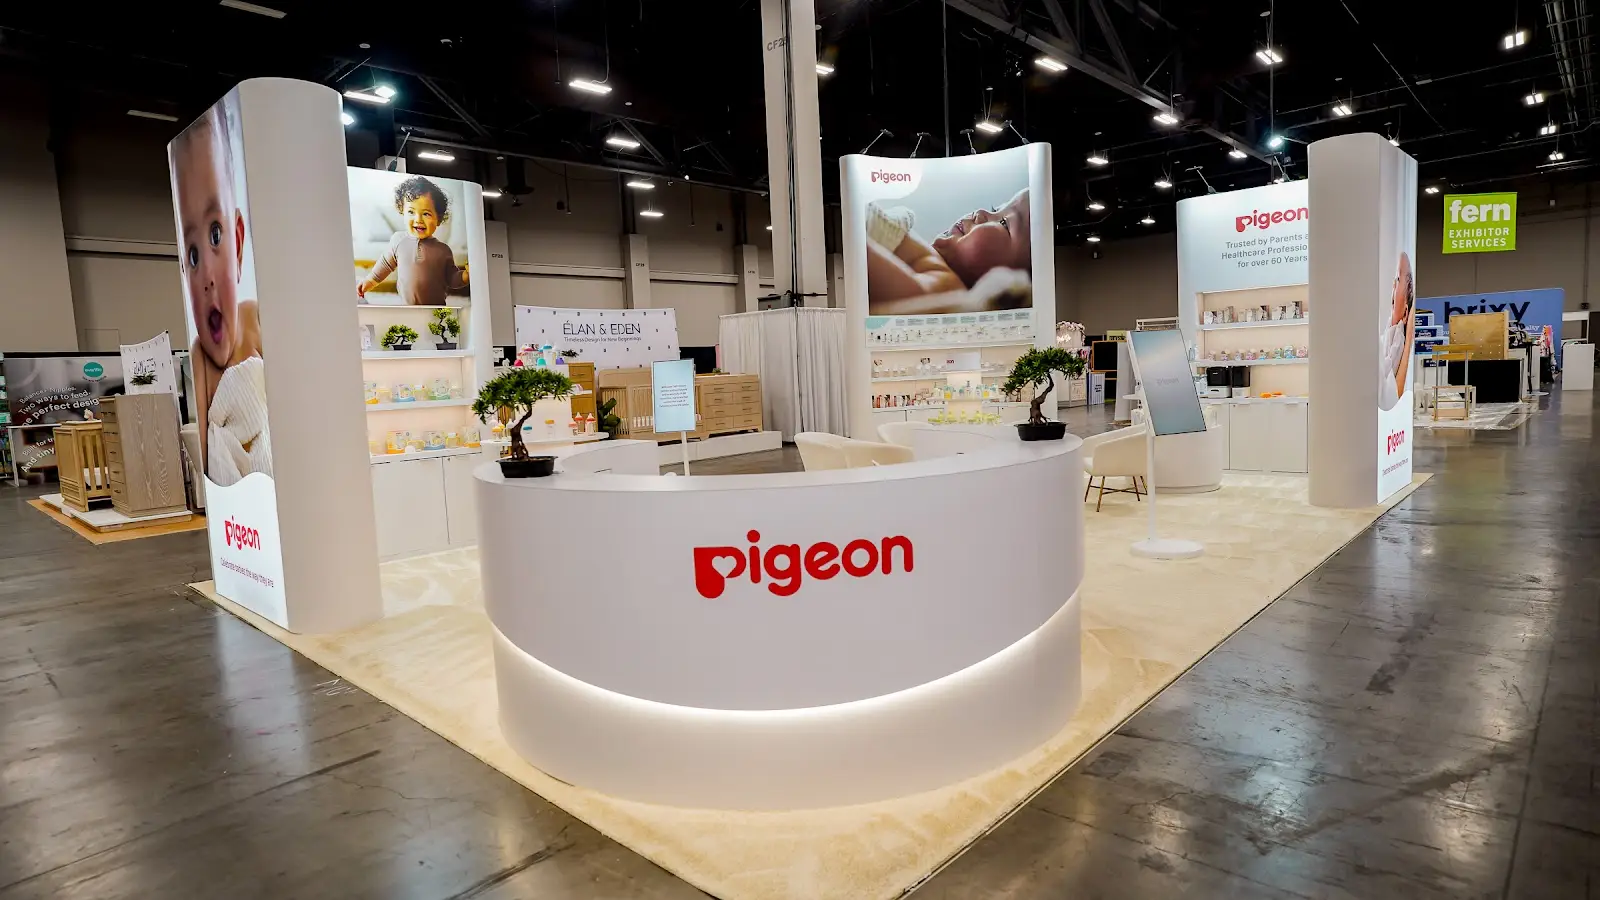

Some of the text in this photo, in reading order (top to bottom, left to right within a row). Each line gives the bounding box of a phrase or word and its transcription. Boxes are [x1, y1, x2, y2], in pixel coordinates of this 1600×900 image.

[871, 169, 911, 184] pigeon
[1235, 207, 1309, 232] pigeon
[1449, 199, 1511, 223] fern
[1225, 238, 1256, 248] Trusted
[1258, 237, 1267, 246] by
[1269, 234, 1303, 243] Parents
[1449, 227, 1510, 238] EXHIBITOR
[1451, 238, 1506, 249] SERVICES
[1221, 249, 1266, 260] Healthcare
[1237, 255, 1308, 268] for over 60 Years
[563, 320, 641, 335] ÉLAN & EDEN
[18, 403, 36, 415] Two
[35, 394, 59, 405] ways
[60, 393, 70, 401] to
[32, 401, 71, 420] perfect
[23, 445, 37, 456] Built
[36, 439, 47, 447] for
[20, 447, 55, 473] And tiny
[224, 514, 261, 550] pigeon
[693, 529, 914, 599] pigeon
